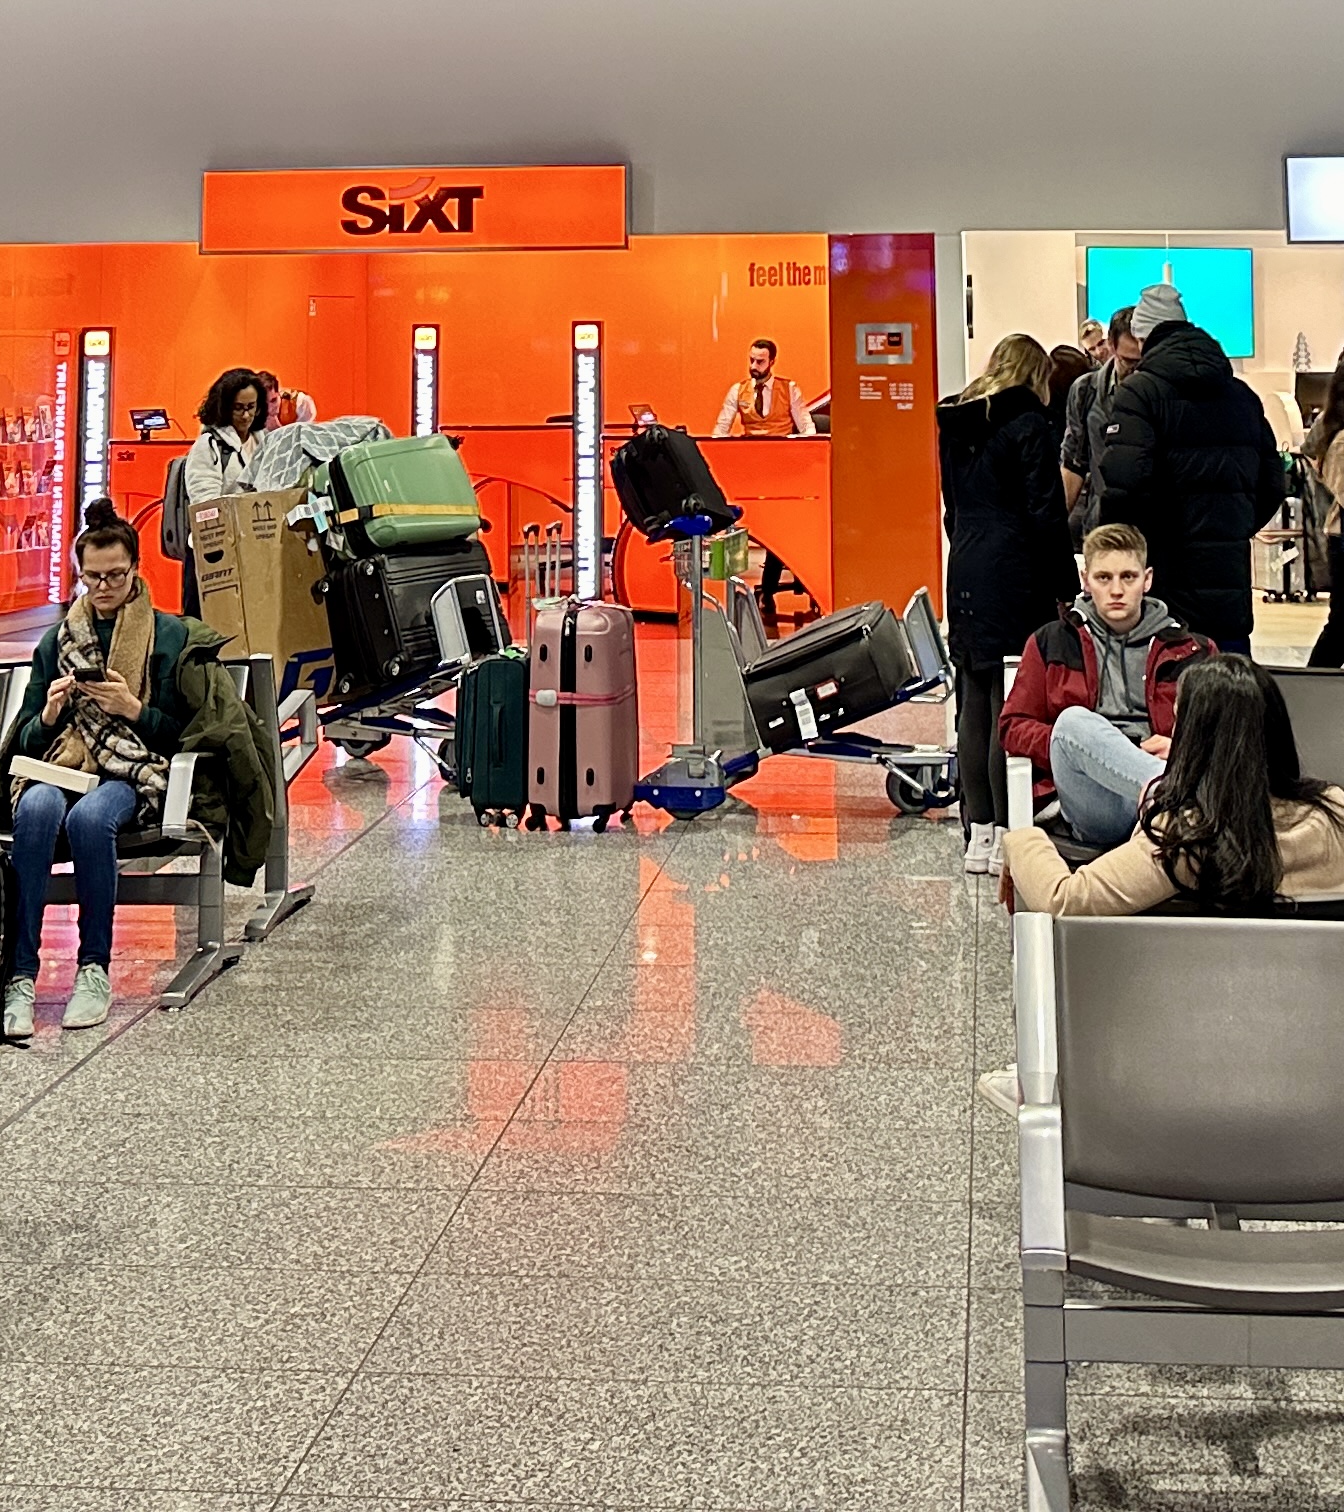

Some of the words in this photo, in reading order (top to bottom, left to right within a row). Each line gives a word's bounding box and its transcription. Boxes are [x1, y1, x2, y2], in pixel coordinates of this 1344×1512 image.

[748, 261, 784, 287] feel
[785, 261, 812, 286] the
[85, 359, 106, 461] FRANKFURT
[417, 353, 433, 438] RANKFURT
[577, 353, 595, 456] FRANKFURT
[84, 462, 103, 485] IN
[578, 458, 595, 478] IN
[578, 480, 595, 601] WILLKOMMEN
